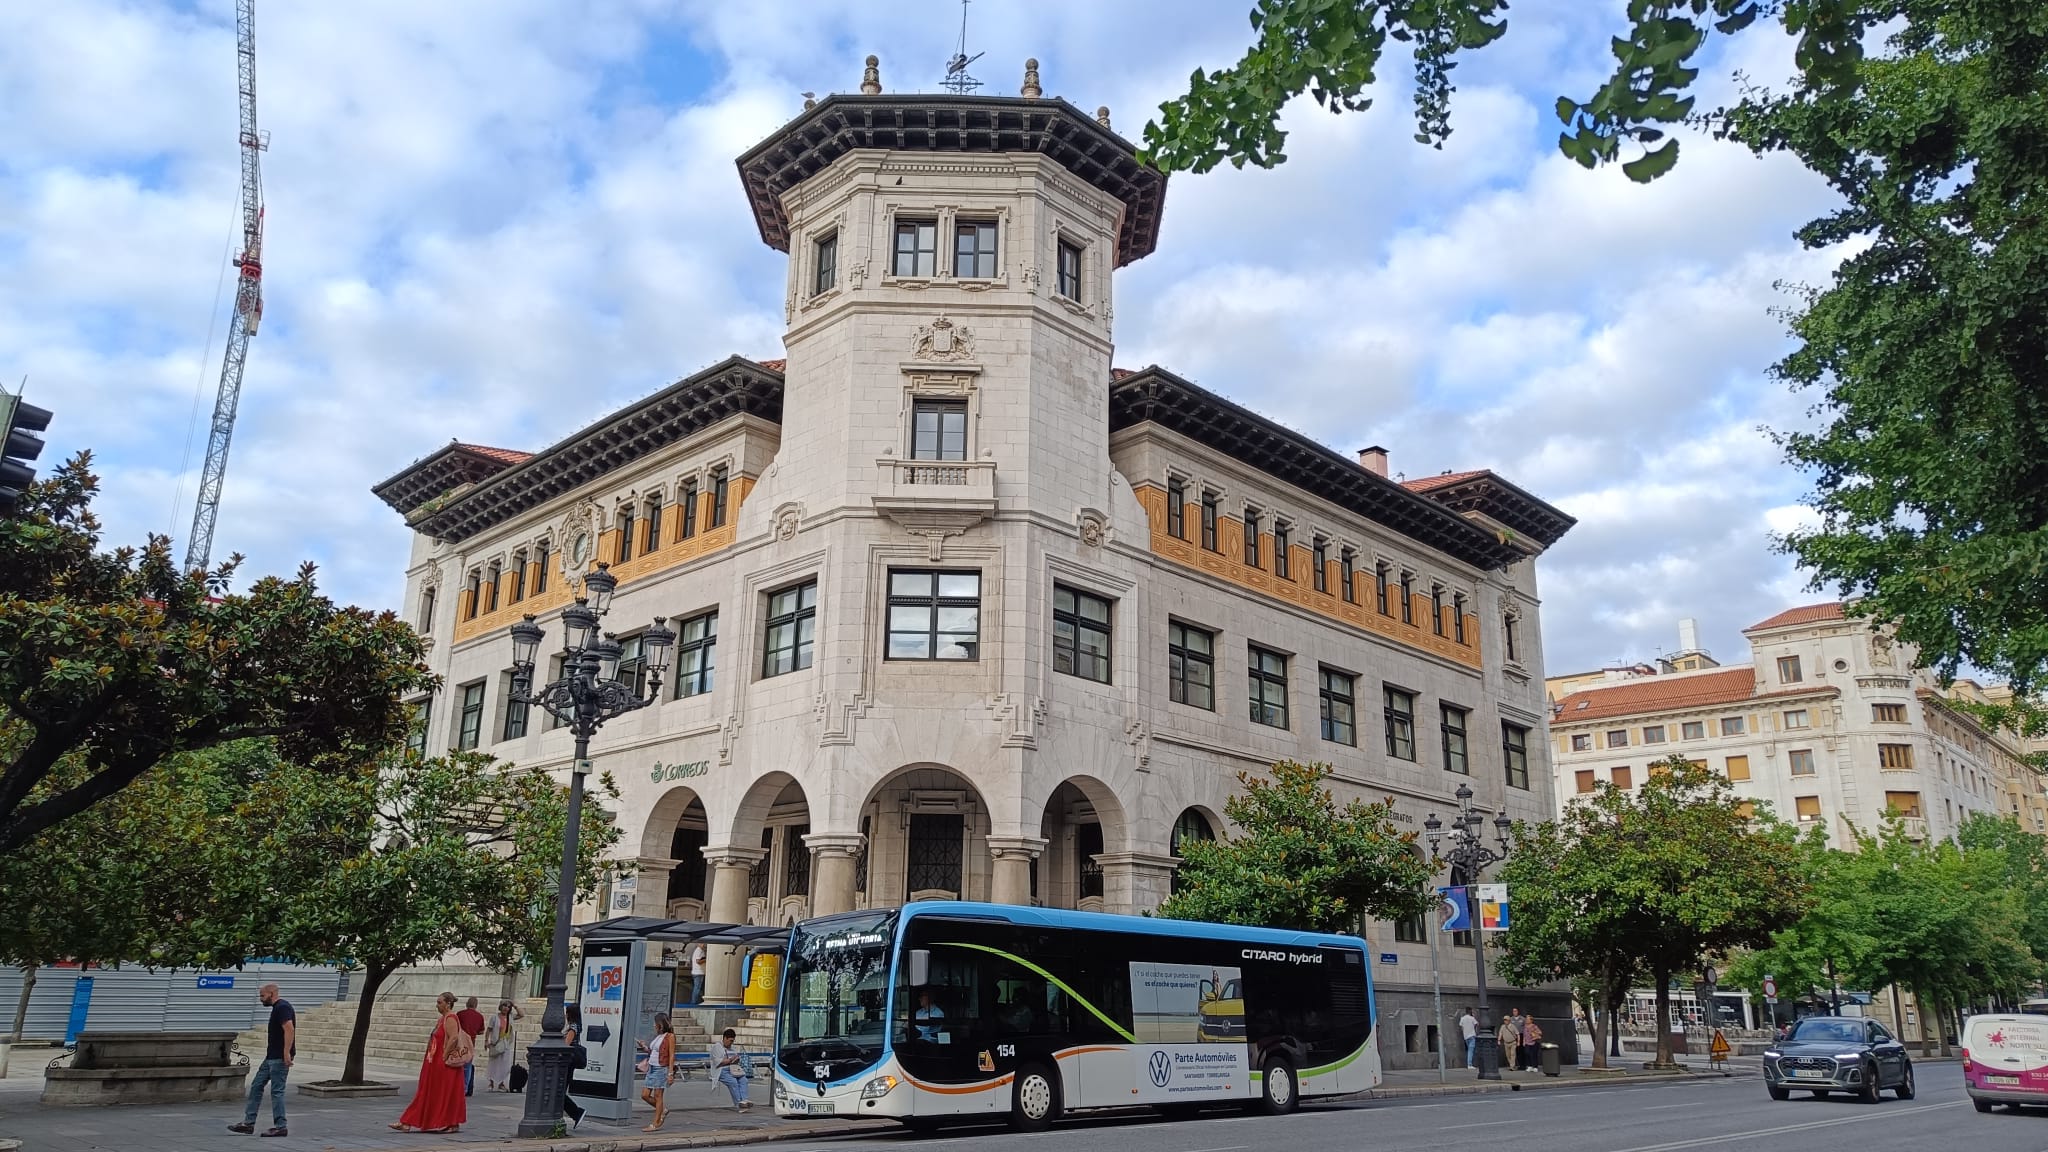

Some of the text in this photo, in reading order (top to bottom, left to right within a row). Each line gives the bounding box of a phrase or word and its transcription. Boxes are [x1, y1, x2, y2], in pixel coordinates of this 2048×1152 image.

[1387, 809, 1413, 824] EGRAFOS
[1241, 948, 1323, 965] CITARO hybrid
[587, 965, 622, 999] lupa
[996, 1044, 1016, 1057] 154
[1174, 1052, 1237, 1063] Parte Automóviles
[813, 1064, 831, 1079] 154
